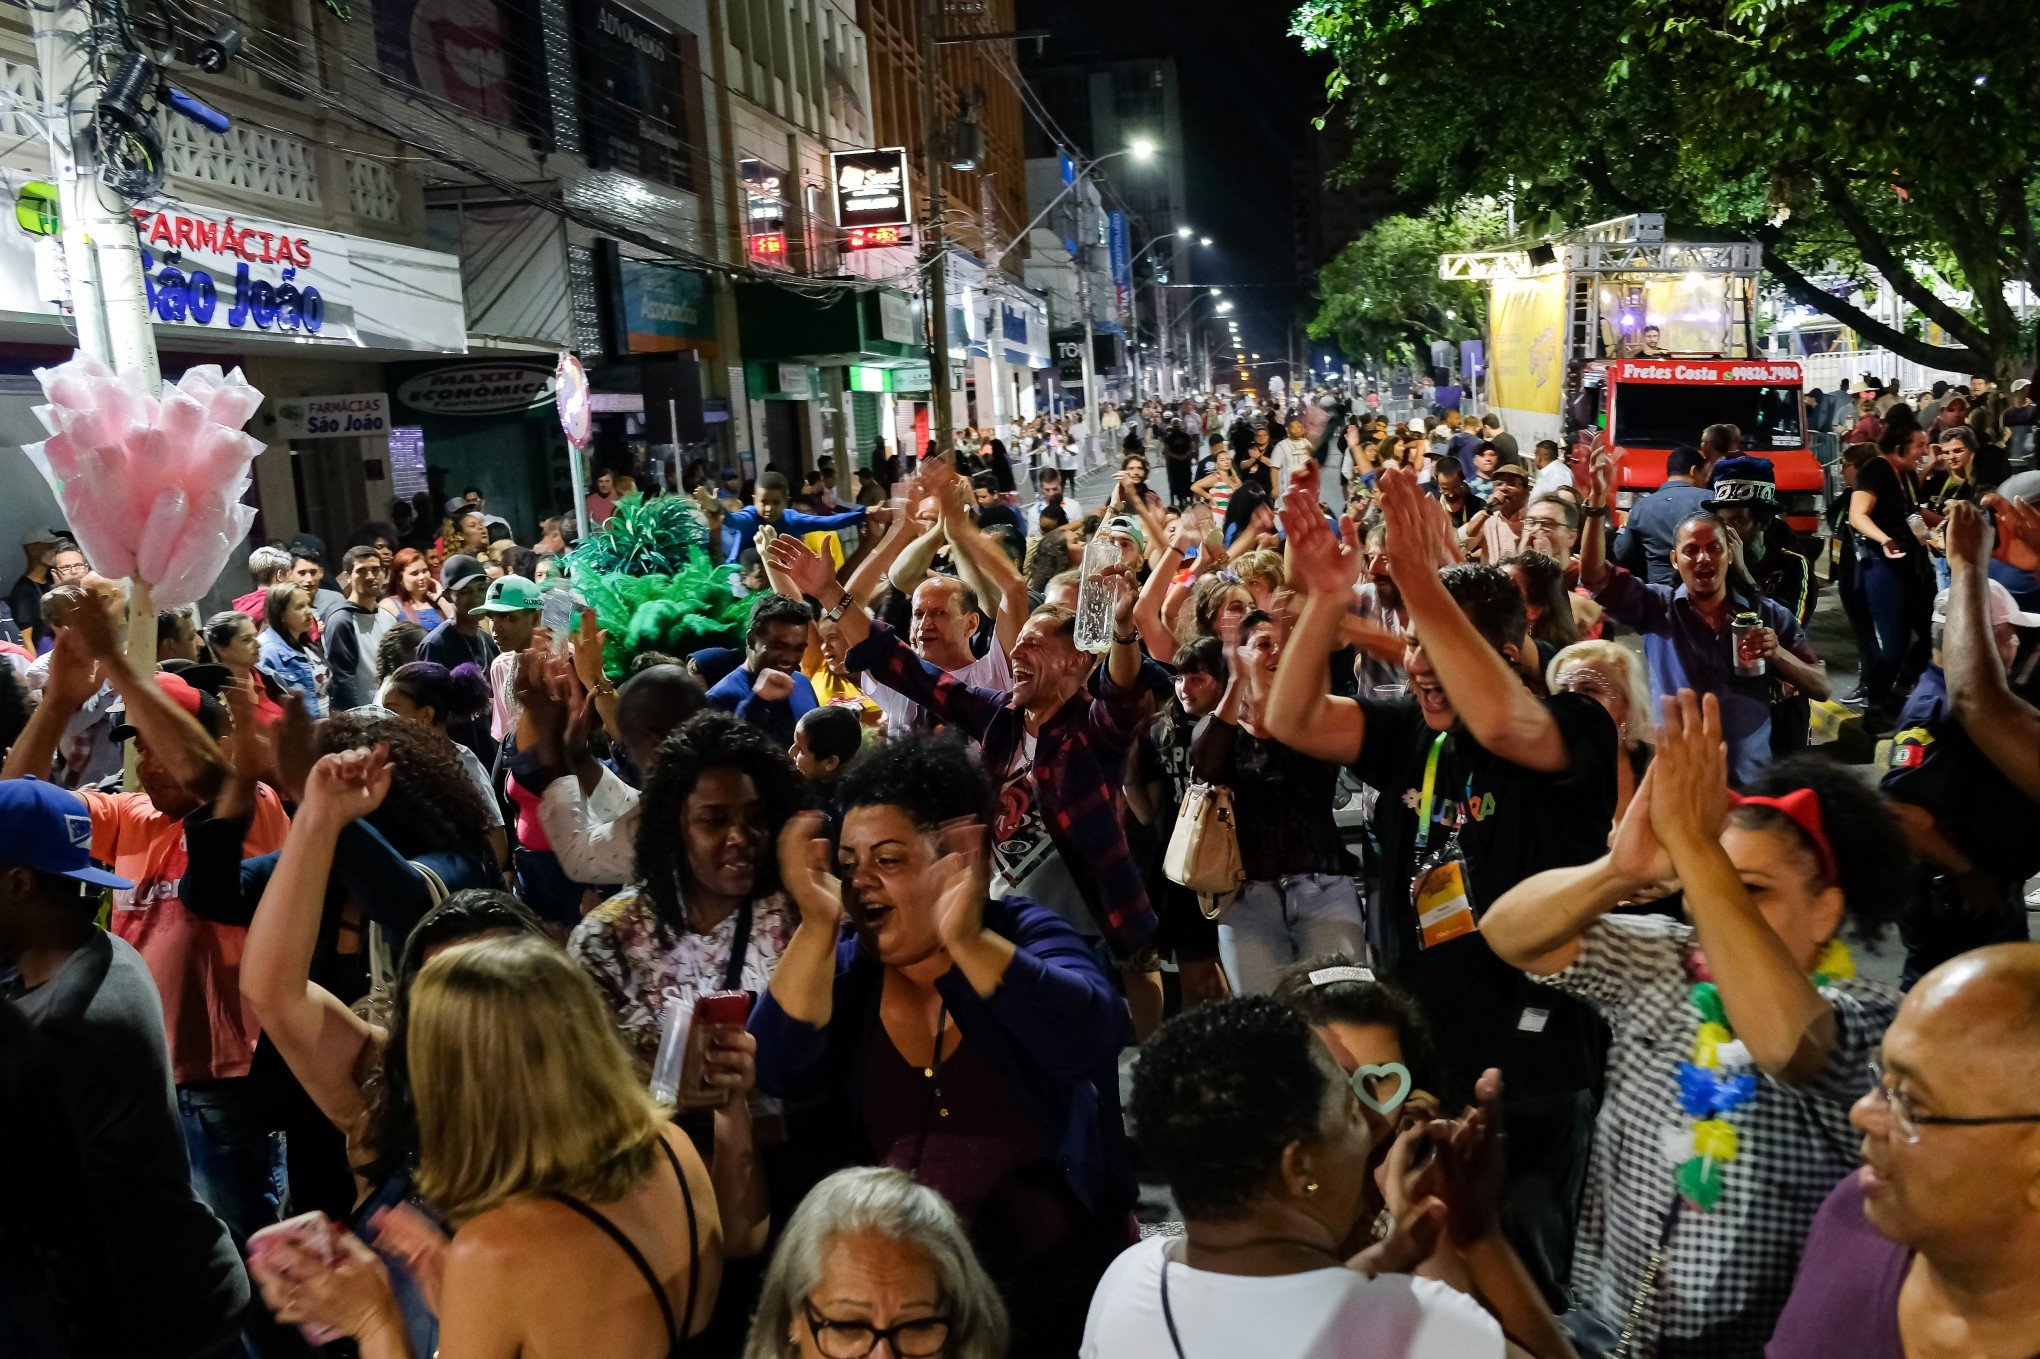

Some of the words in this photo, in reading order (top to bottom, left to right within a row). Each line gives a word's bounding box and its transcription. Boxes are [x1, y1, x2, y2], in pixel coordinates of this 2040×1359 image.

[130, 208, 311, 268] FARMÁCIAS
[141, 249, 217, 325] ão
[229, 262, 324, 333] João
[430, 370, 524, 386] MAXXI
[1623, 364, 1672, 379] Fretes
[1675, 365, 1718, 381] Costa
[409, 380, 549, 402] ECONÔMICA
[308, 400, 380, 414] FARMÁCIAS
[307, 414, 339, 433] São
[344, 413, 384, 432] João
